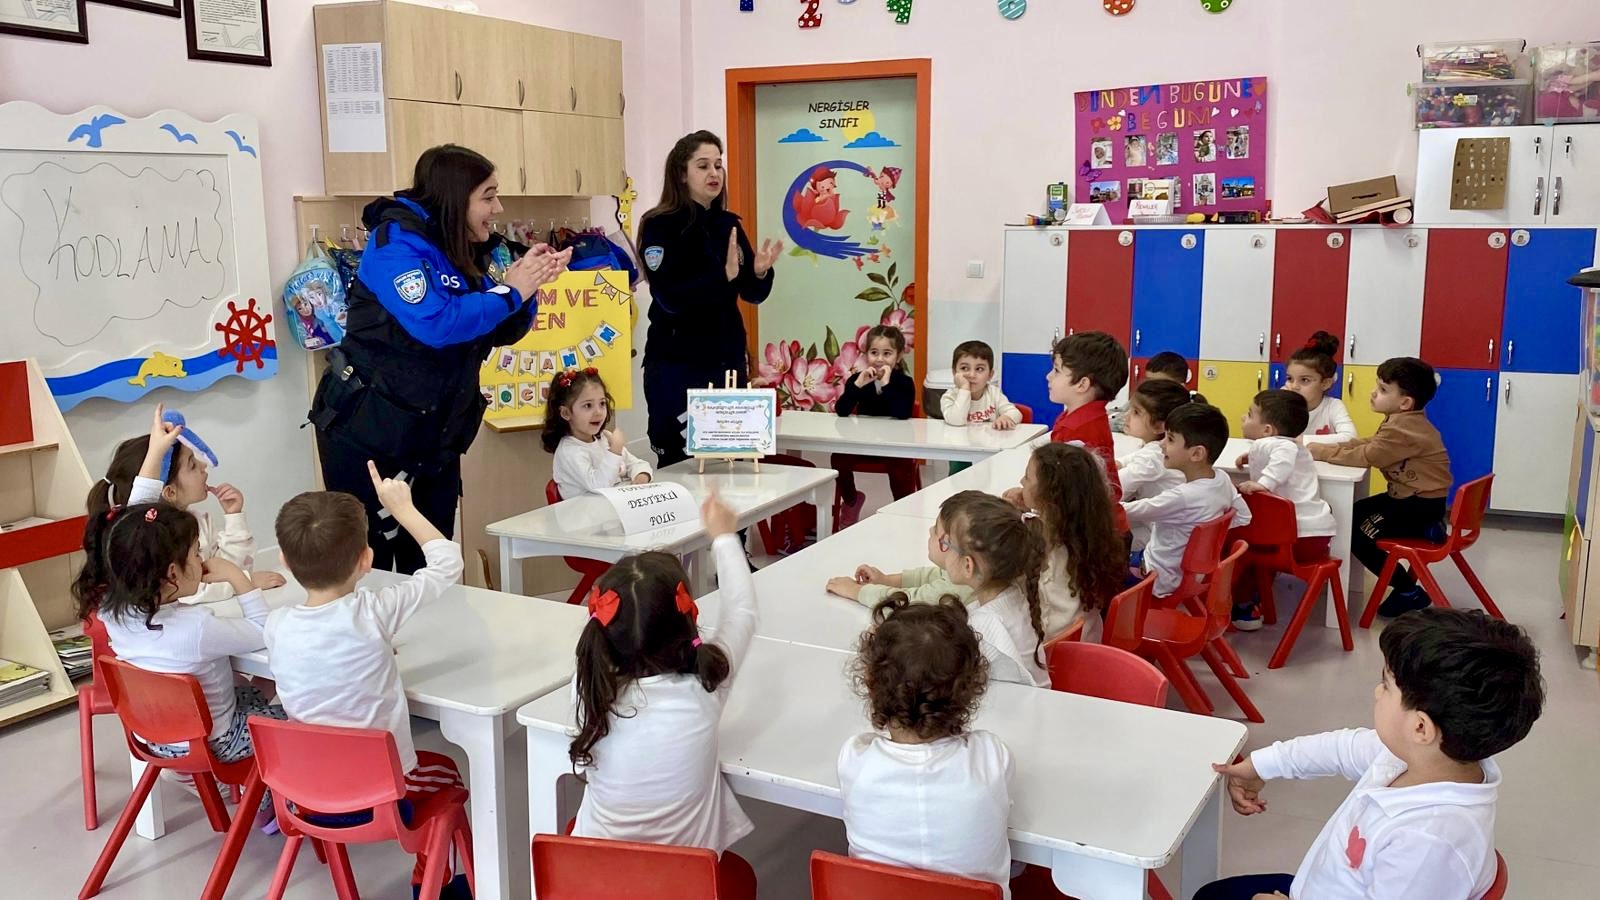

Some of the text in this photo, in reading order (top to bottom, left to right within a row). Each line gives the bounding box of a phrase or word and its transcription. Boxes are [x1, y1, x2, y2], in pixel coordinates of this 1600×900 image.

[808, 100, 870, 113] NERGİSLER
[818, 117, 860, 129] SINIFI
[43, 186, 212, 283] KODLAMA
[564, 288, 600, 308] VE
